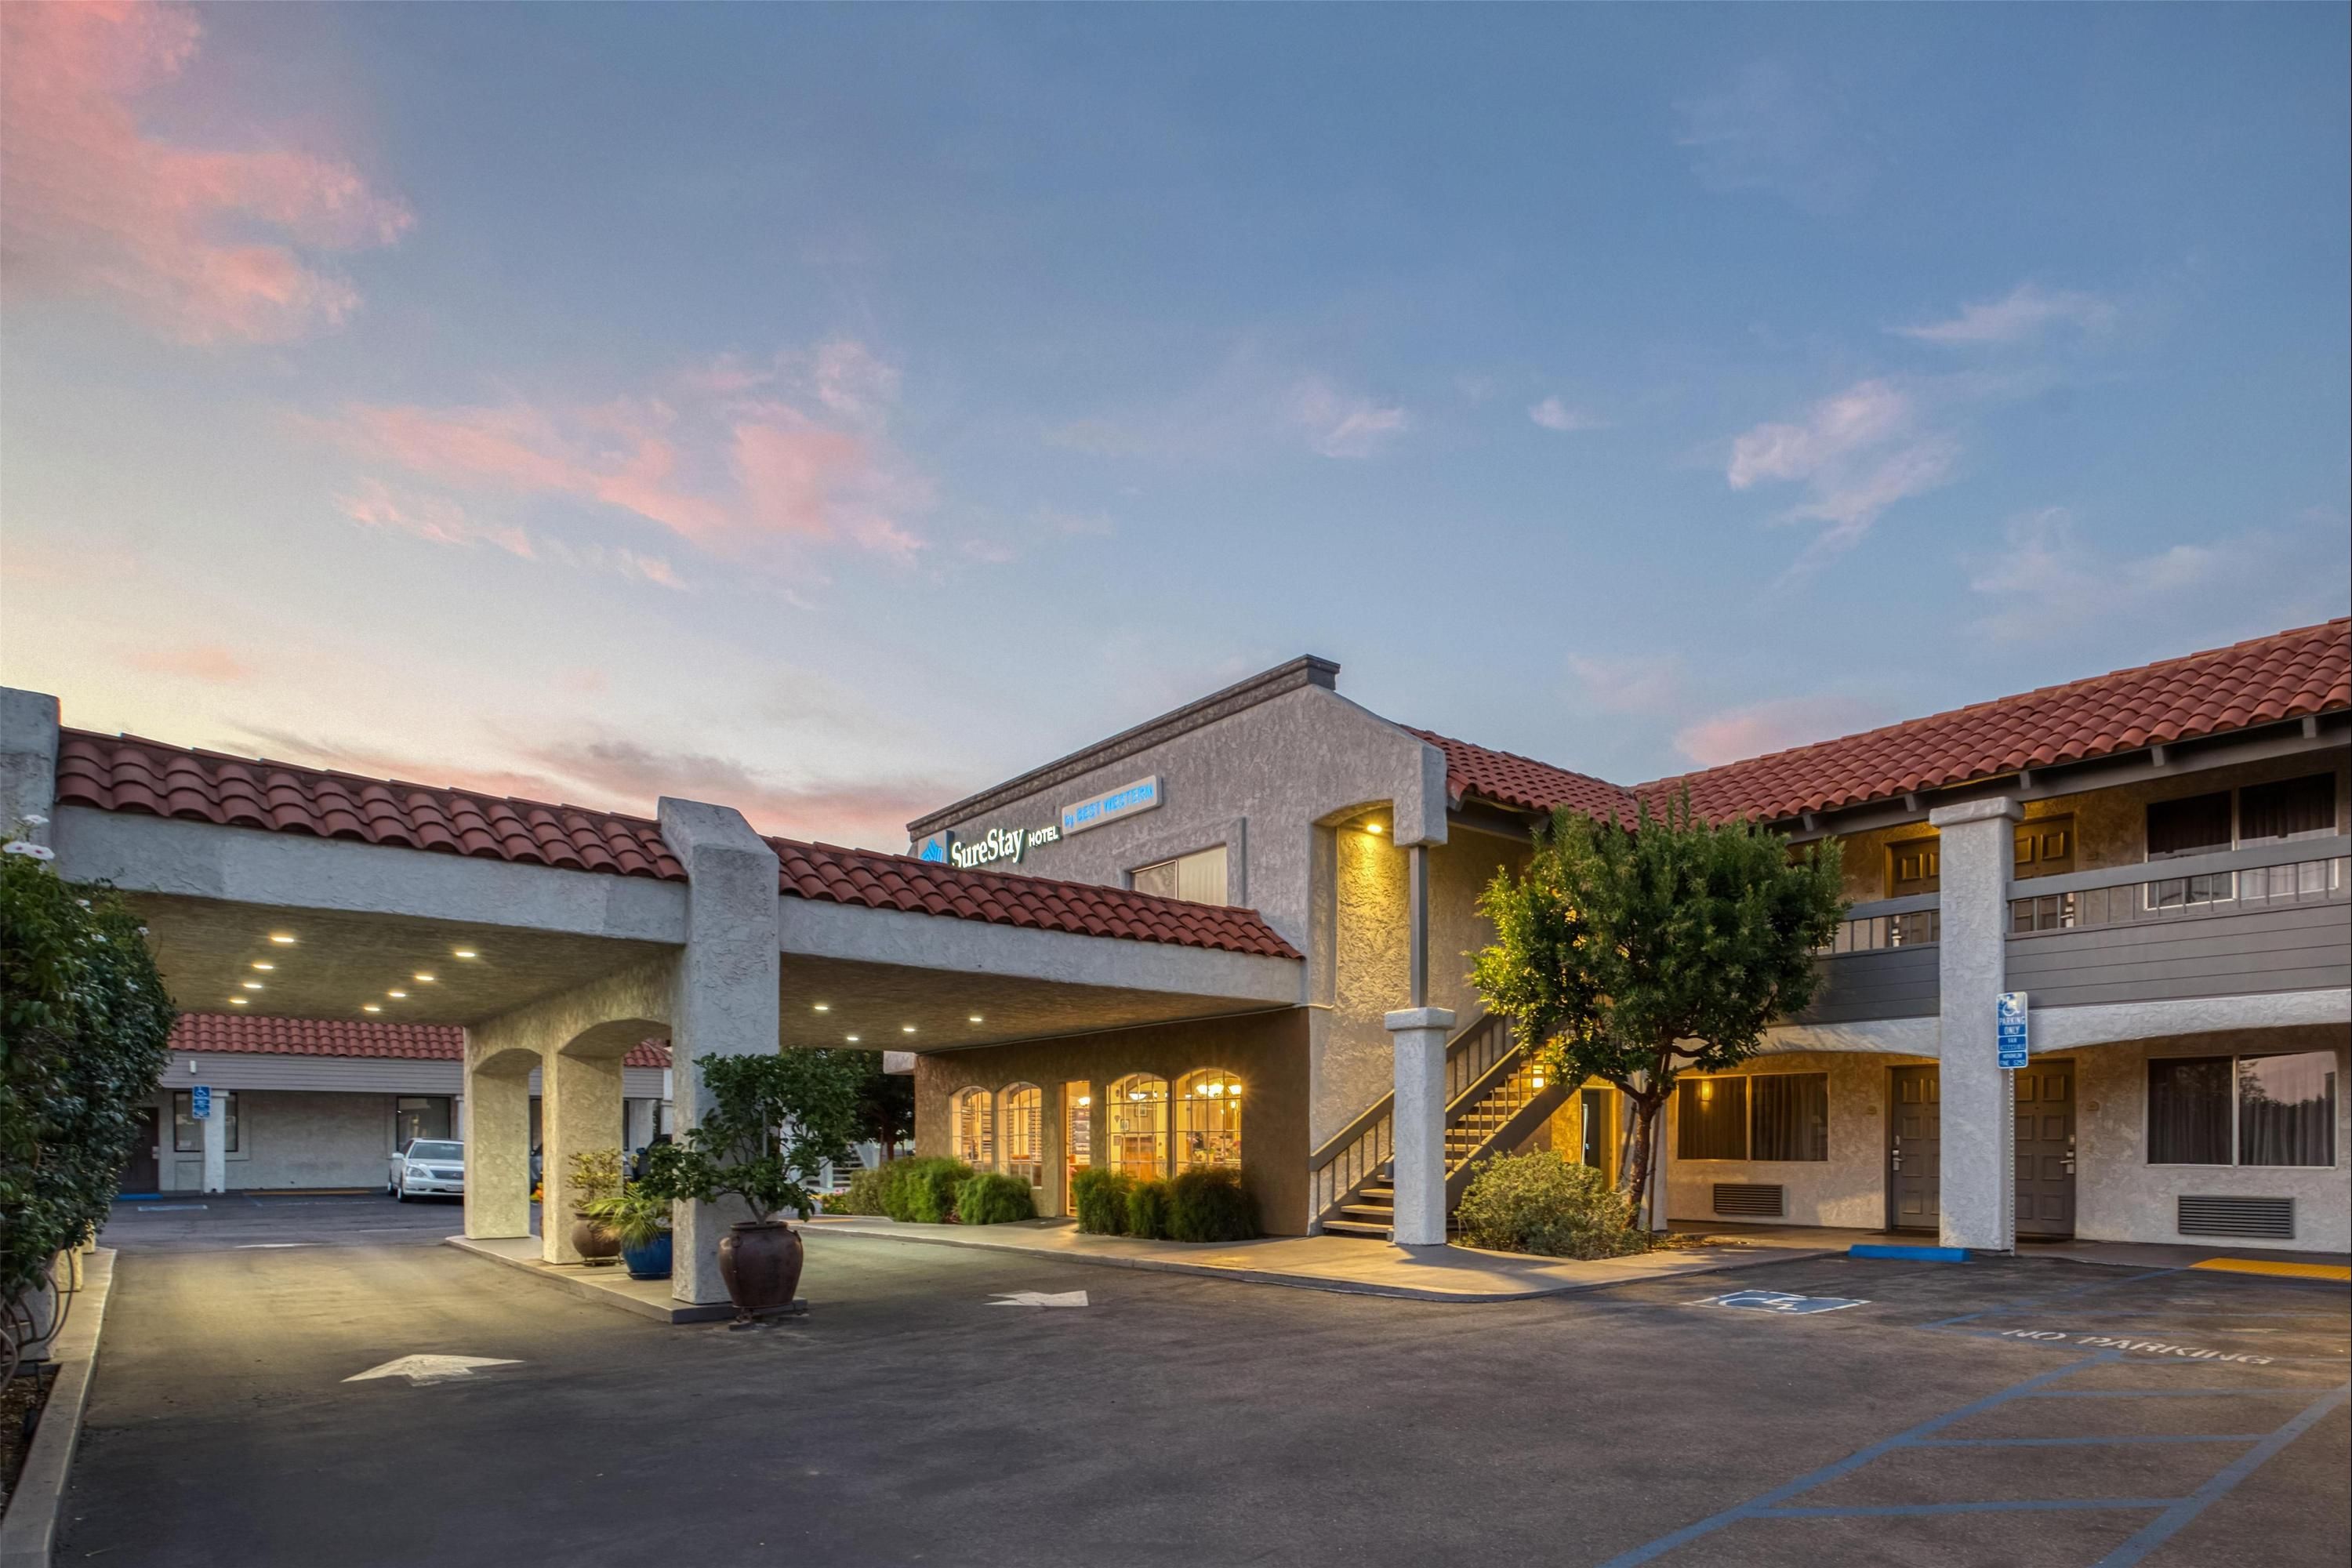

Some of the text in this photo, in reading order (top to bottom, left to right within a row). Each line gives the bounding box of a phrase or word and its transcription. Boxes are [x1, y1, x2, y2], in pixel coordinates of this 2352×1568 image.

[1064, 782, 1154, 828] by BEST WESTERN
[951, 826, 1058, 869] SureStay HOTEL
[1999, 1015, 2026, 1025] PARKING
[2004, 1025, 2020, 1035] ONLY
[2001, 1329, 2274, 1365] NO PARKING
